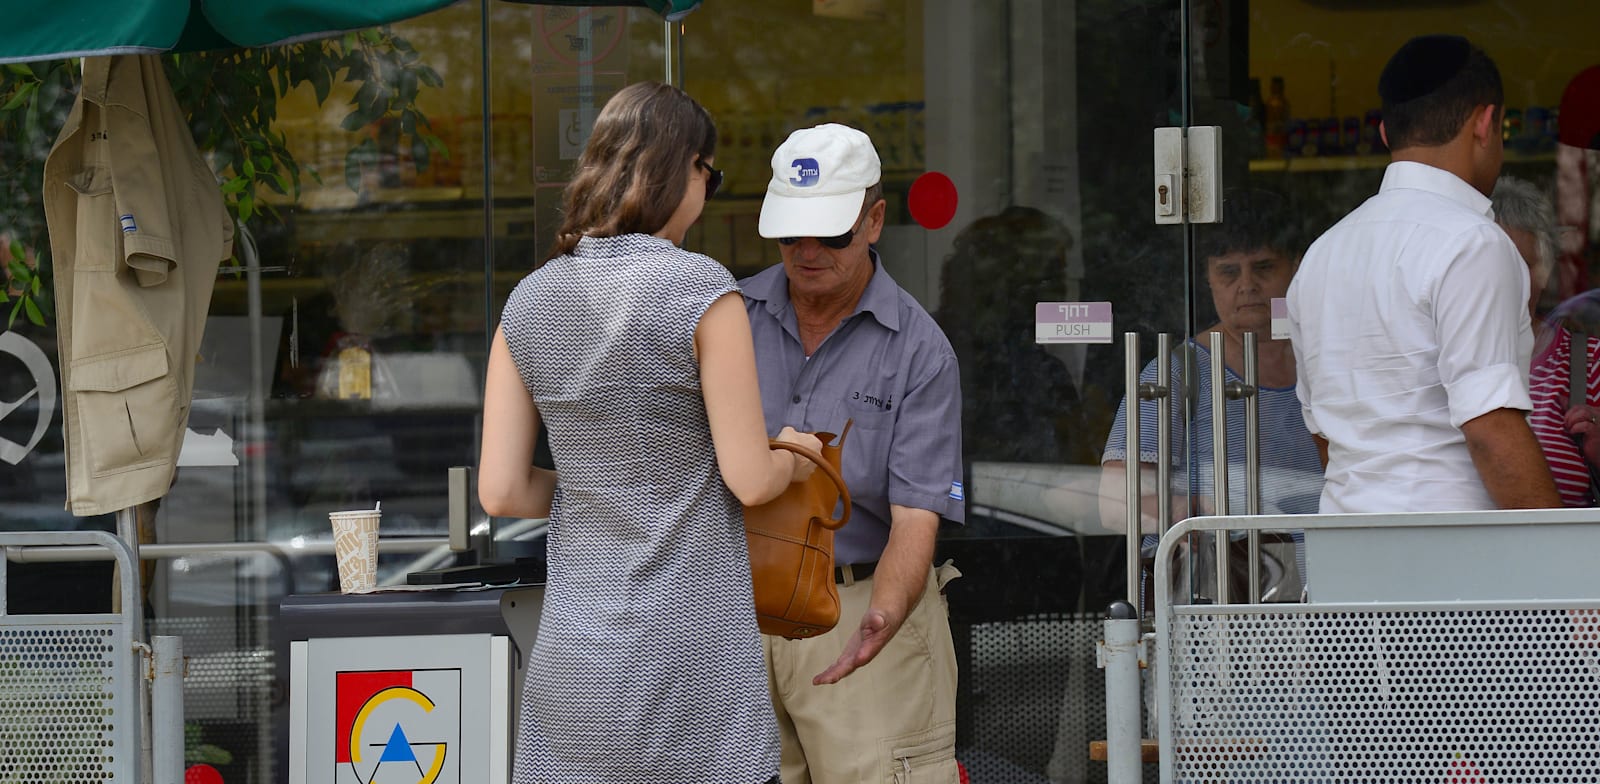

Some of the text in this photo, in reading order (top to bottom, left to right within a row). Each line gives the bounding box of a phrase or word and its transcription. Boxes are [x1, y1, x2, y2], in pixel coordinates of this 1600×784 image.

[1058, 304, 1089, 321] דחף
[1056, 324, 1090, 336] PUSH
[852, 391, 884, 408] צוות 3
